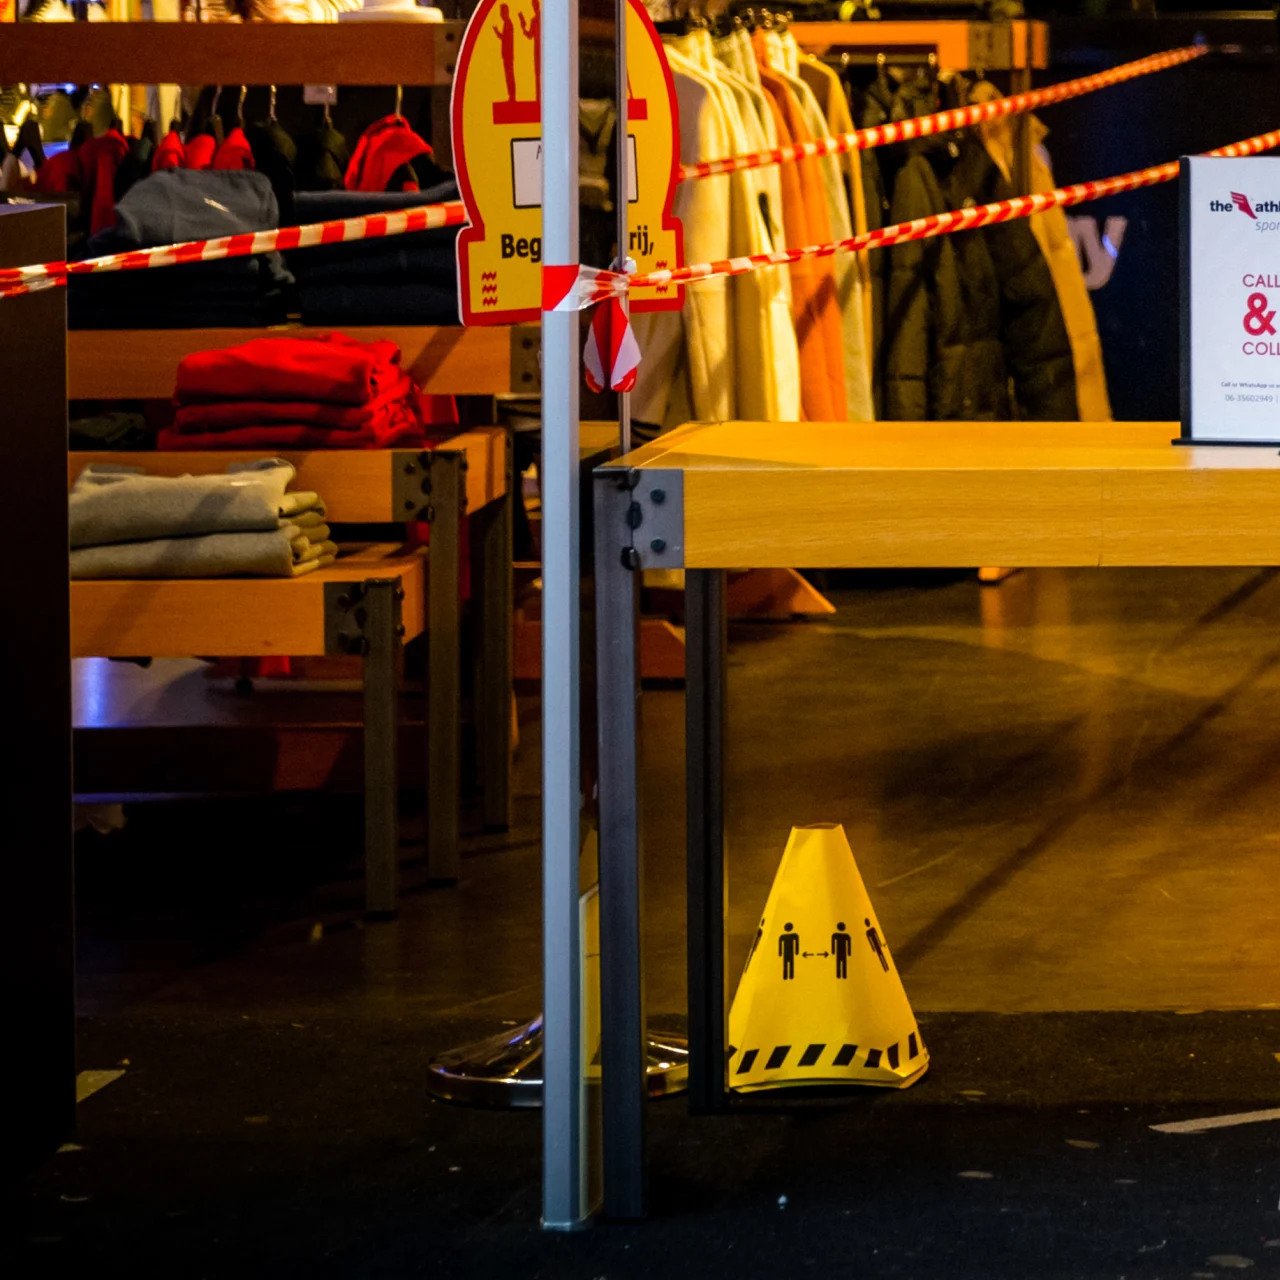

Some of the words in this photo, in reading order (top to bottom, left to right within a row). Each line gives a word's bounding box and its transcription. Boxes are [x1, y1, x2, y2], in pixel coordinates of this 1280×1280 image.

[1209, 200, 1233, 212] the
[1242, 273, 1280, 288] CALL
[1243, 292, 1277, 336] &
[1225, 394, 1273, 403] 06-35602949
